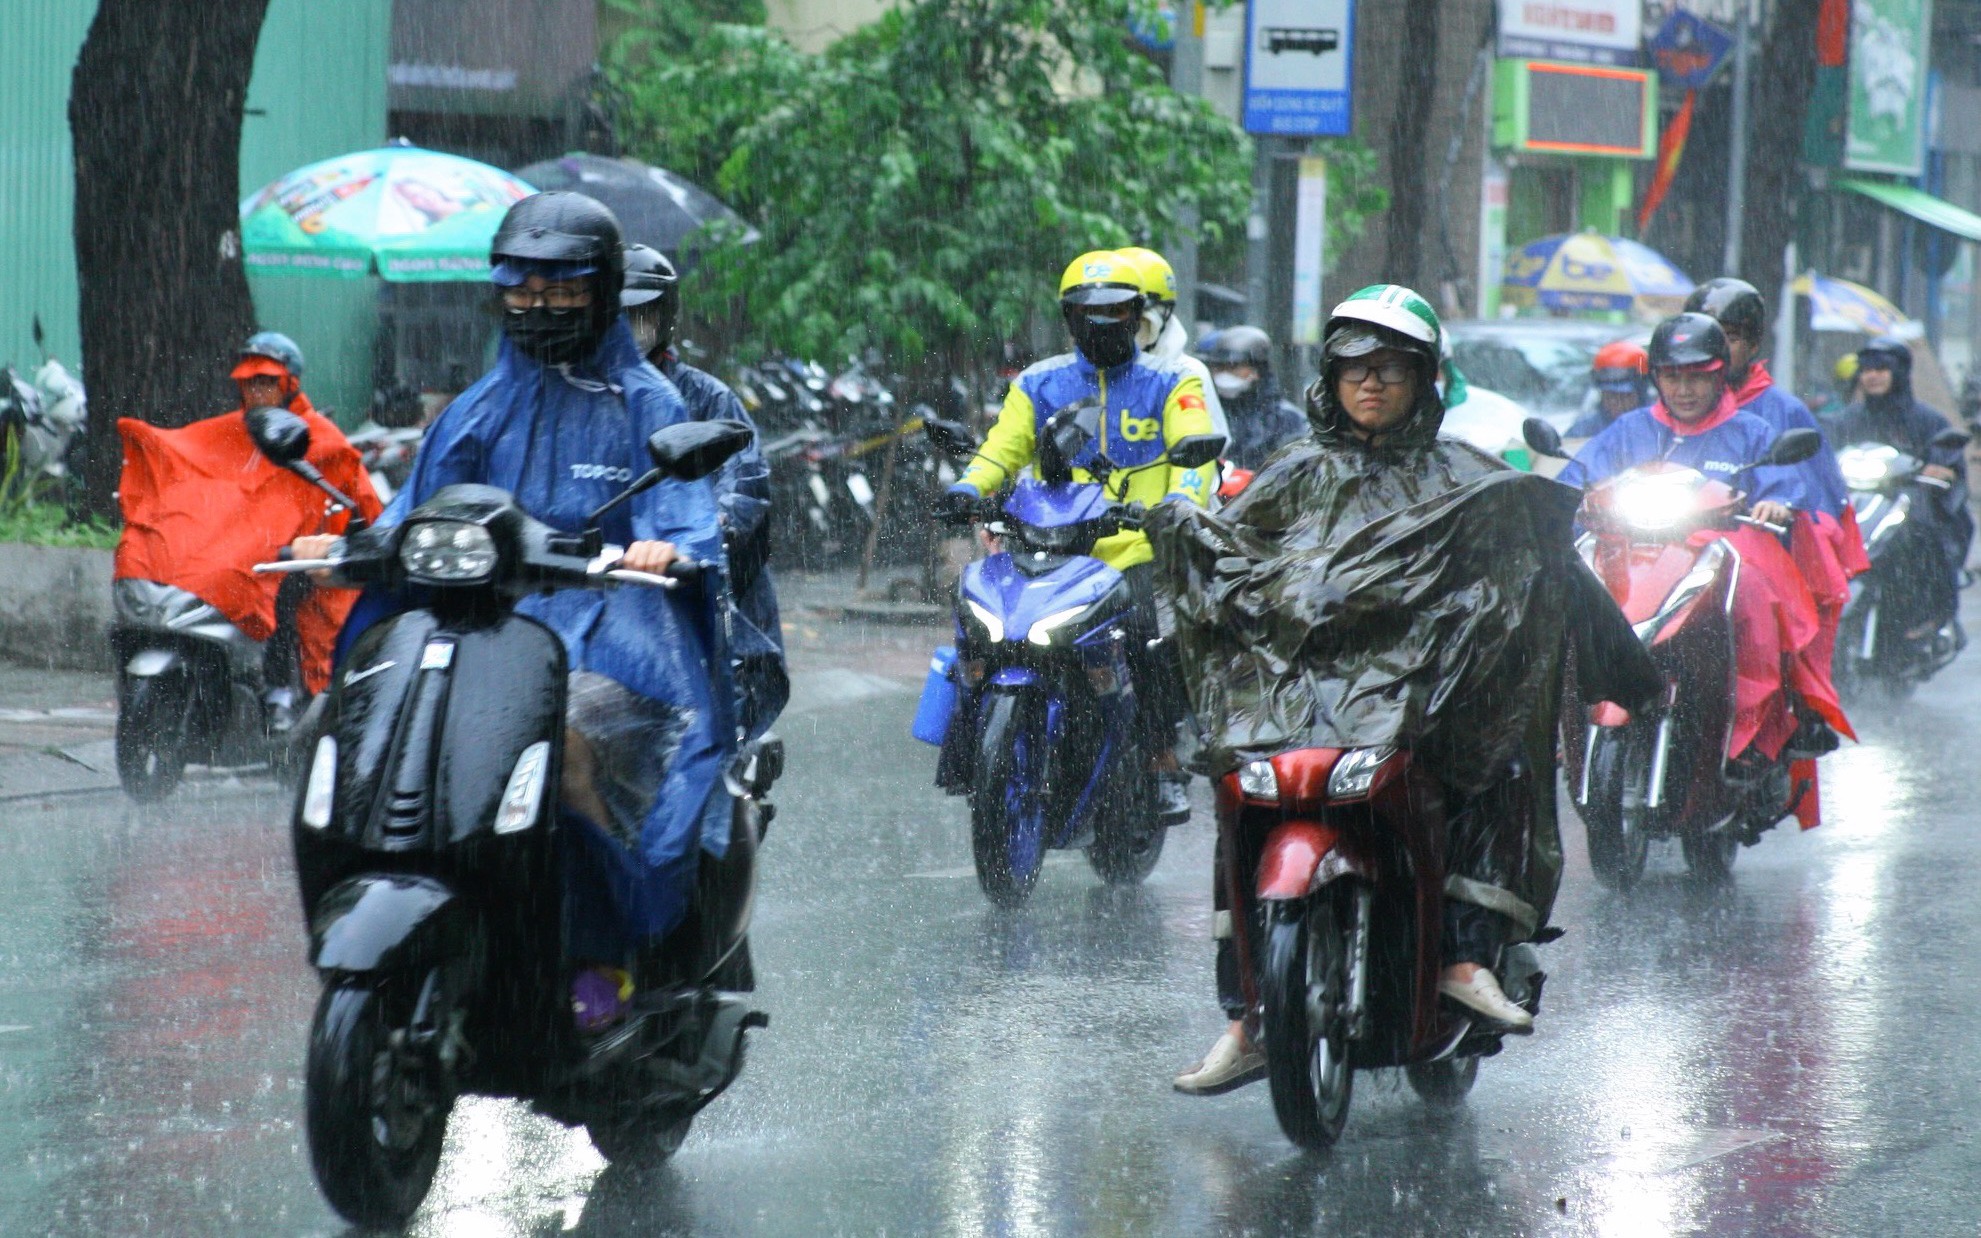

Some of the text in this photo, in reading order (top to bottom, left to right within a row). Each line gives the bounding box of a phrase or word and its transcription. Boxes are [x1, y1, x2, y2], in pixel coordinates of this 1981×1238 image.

[1083, 263, 1112, 278] be
[1120, 409, 1161, 442] be
[569, 463, 634, 482] TOPCO
